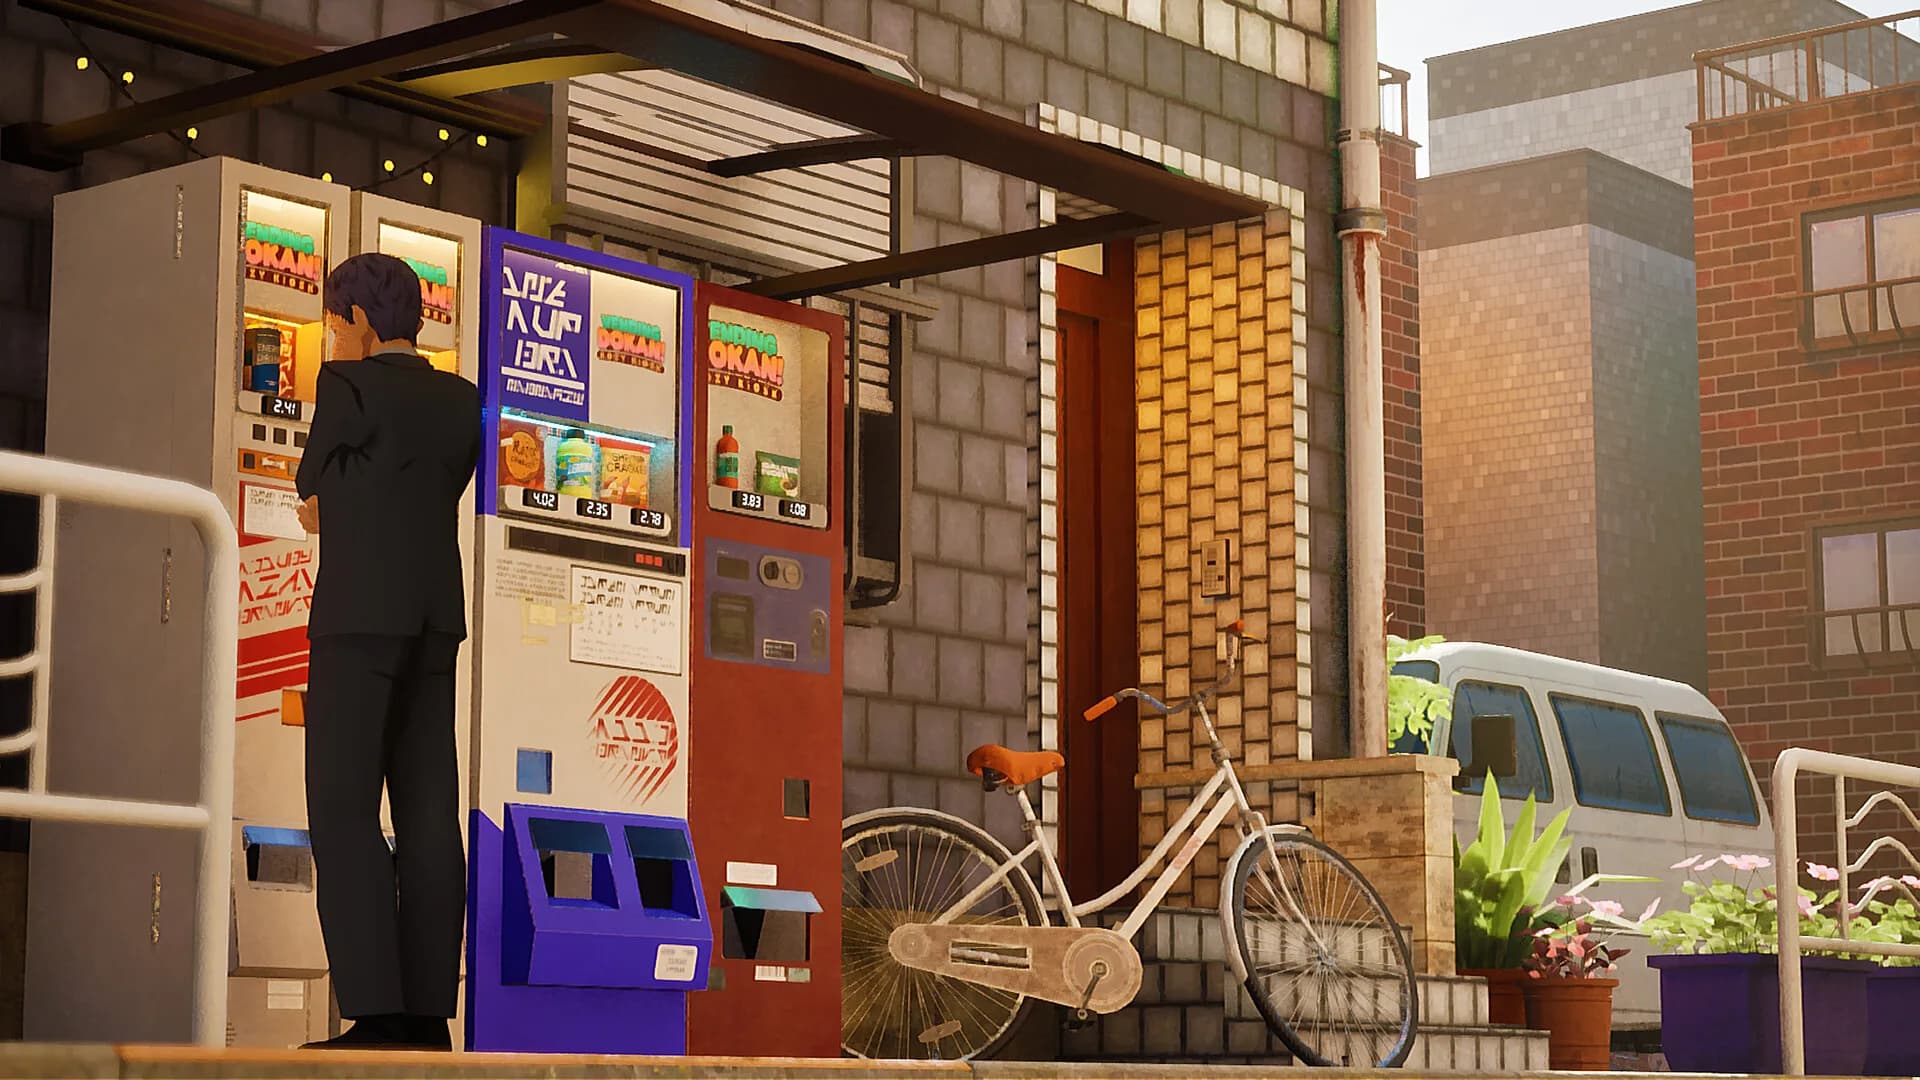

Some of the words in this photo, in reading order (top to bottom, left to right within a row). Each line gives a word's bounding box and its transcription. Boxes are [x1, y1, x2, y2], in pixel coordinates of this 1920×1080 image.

[246, 221, 314, 255] ENDING
[245, 239, 321, 281] OKAN!
[273, 273, 314, 293] KIOSK
[423, 308, 447, 323] OSK
[601, 314, 661, 342] VENDING
[709, 320, 778, 356] ENDING
[597, 326, 665, 363] DOKAN!
[708, 340, 784, 386] OKAN!
[708, 372, 730, 385] ZY
[738, 378, 777, 398] KIOSK
[273, 399, 296, 415] 2.41
[533, 492, 555, 508] 4.02
[586, 501, 609, 517] 2.35
[742, 494, 762, 509] 3.83
[640, 510, 662, 526] 2.78
[789, 503, 807, 518] 1.08
